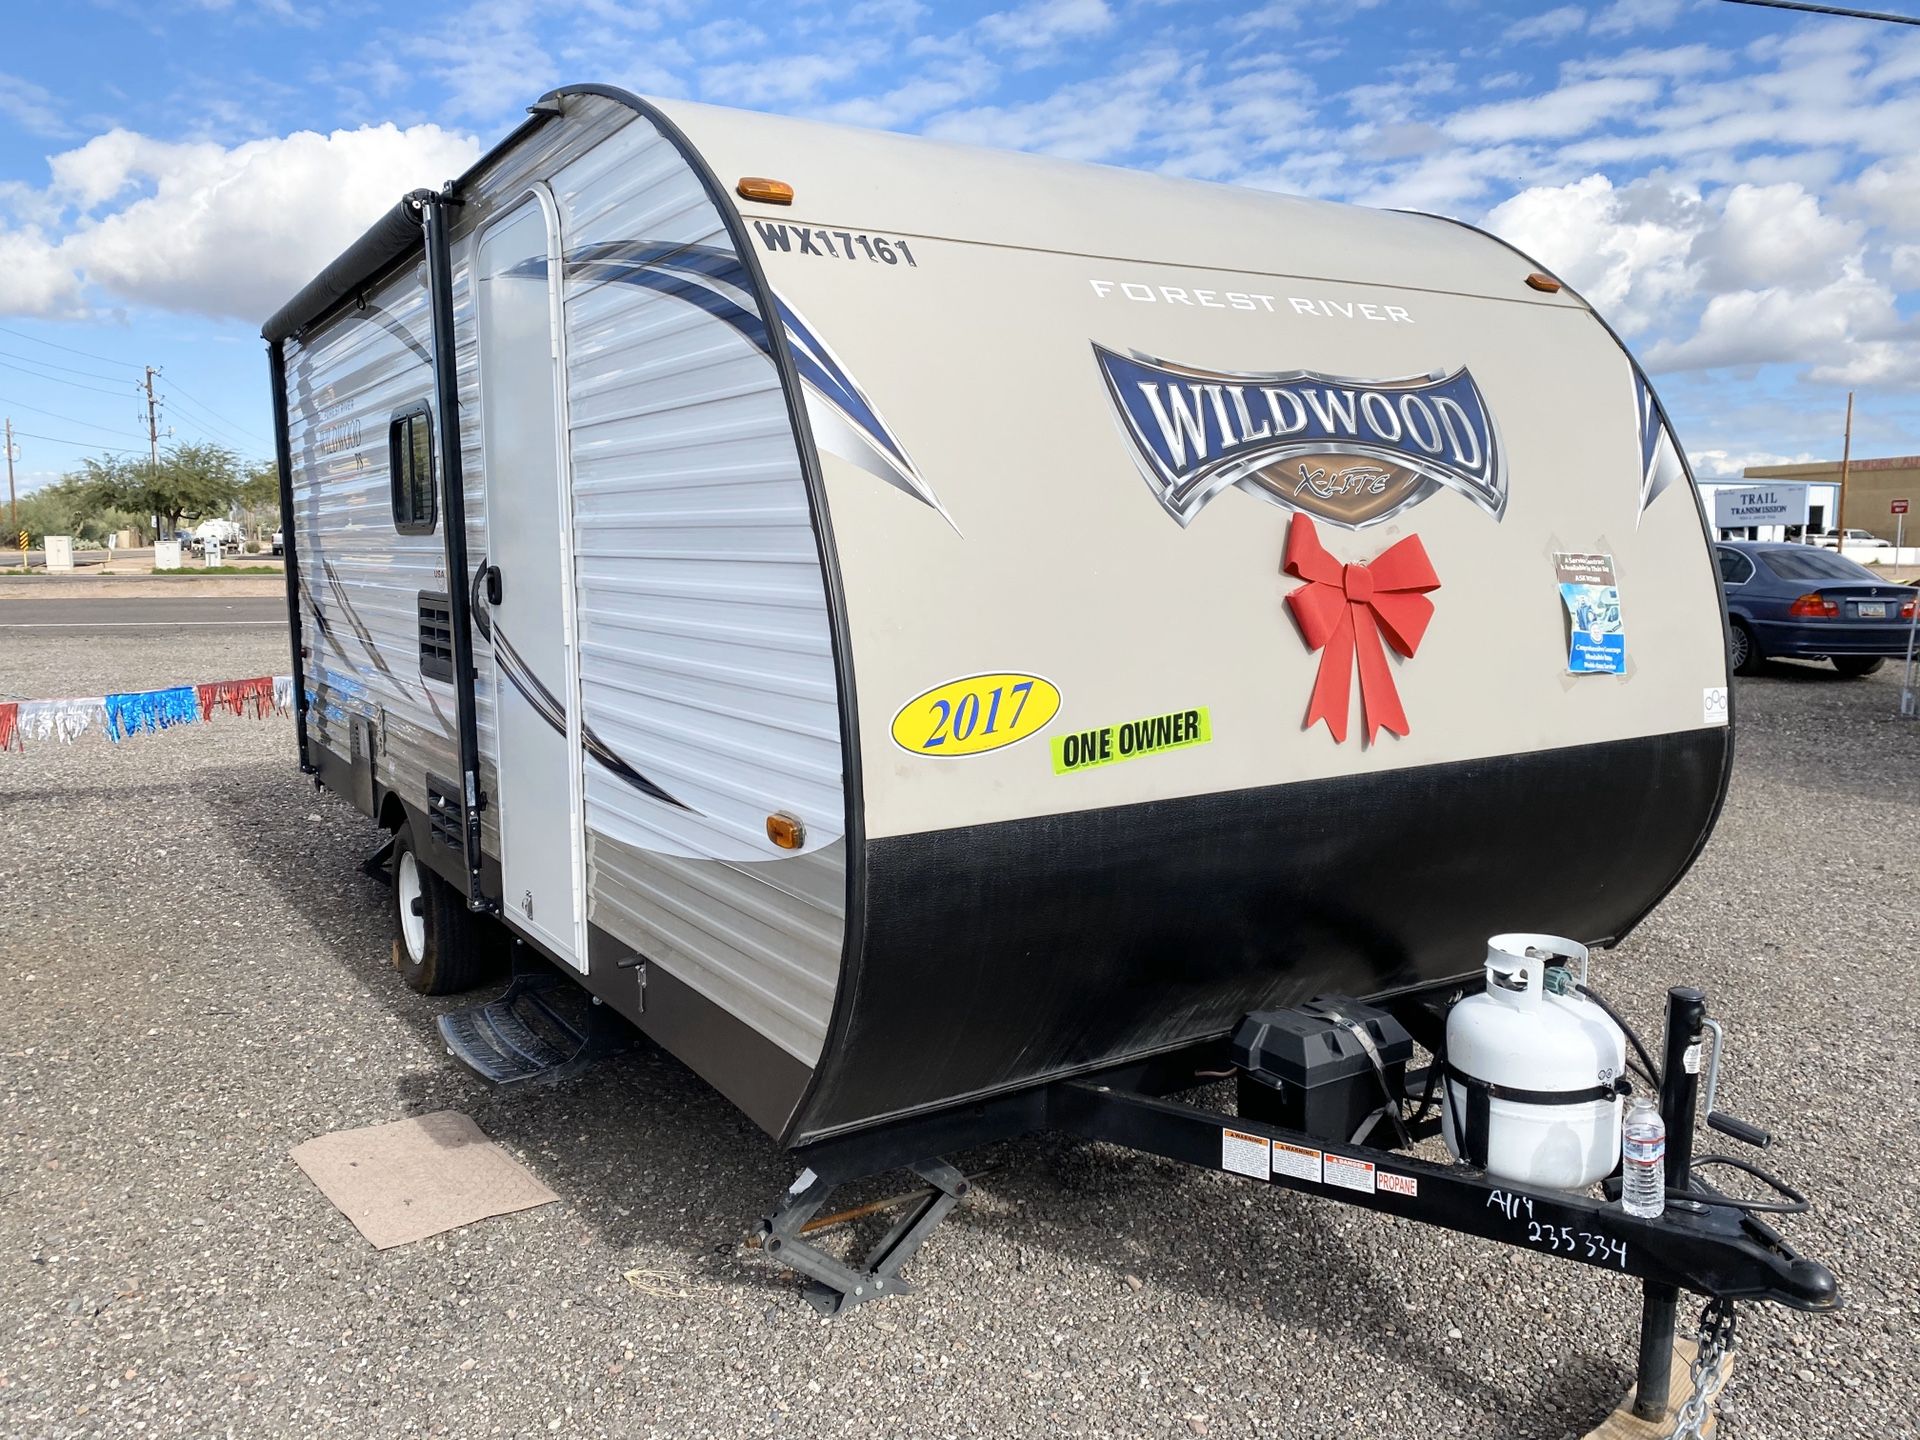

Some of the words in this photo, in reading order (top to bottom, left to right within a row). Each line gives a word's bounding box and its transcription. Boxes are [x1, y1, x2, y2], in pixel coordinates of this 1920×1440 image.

[753, 220, 917, 268] WX17161
[1088, 279, 1275, 312] FOREST
[1287, 297, 1416, 323] RIVER
[1136, 381, 1483, 471] WILDWOOD
[1293, 462, 1391, 499] X-LITE
[1740, 492, 1778, 505] TRAIL
[1731, 505, 1787, 515] TRANSMISSION
[922, 680, 1035, 749] 2017
[1062, 728, 1112, 768] ONE
[1118, 709, 1200, 755] OWNER
[1235, 1133, 1262, 1144] WARNING
[1285, 1146, 1313, 1156] WARNING
[1338, 1157, 1366, 1168] DANGER
[1378, 1173, 1415, 1195] PROPANE
[1528, 1221, 1627, 1268] 235334
